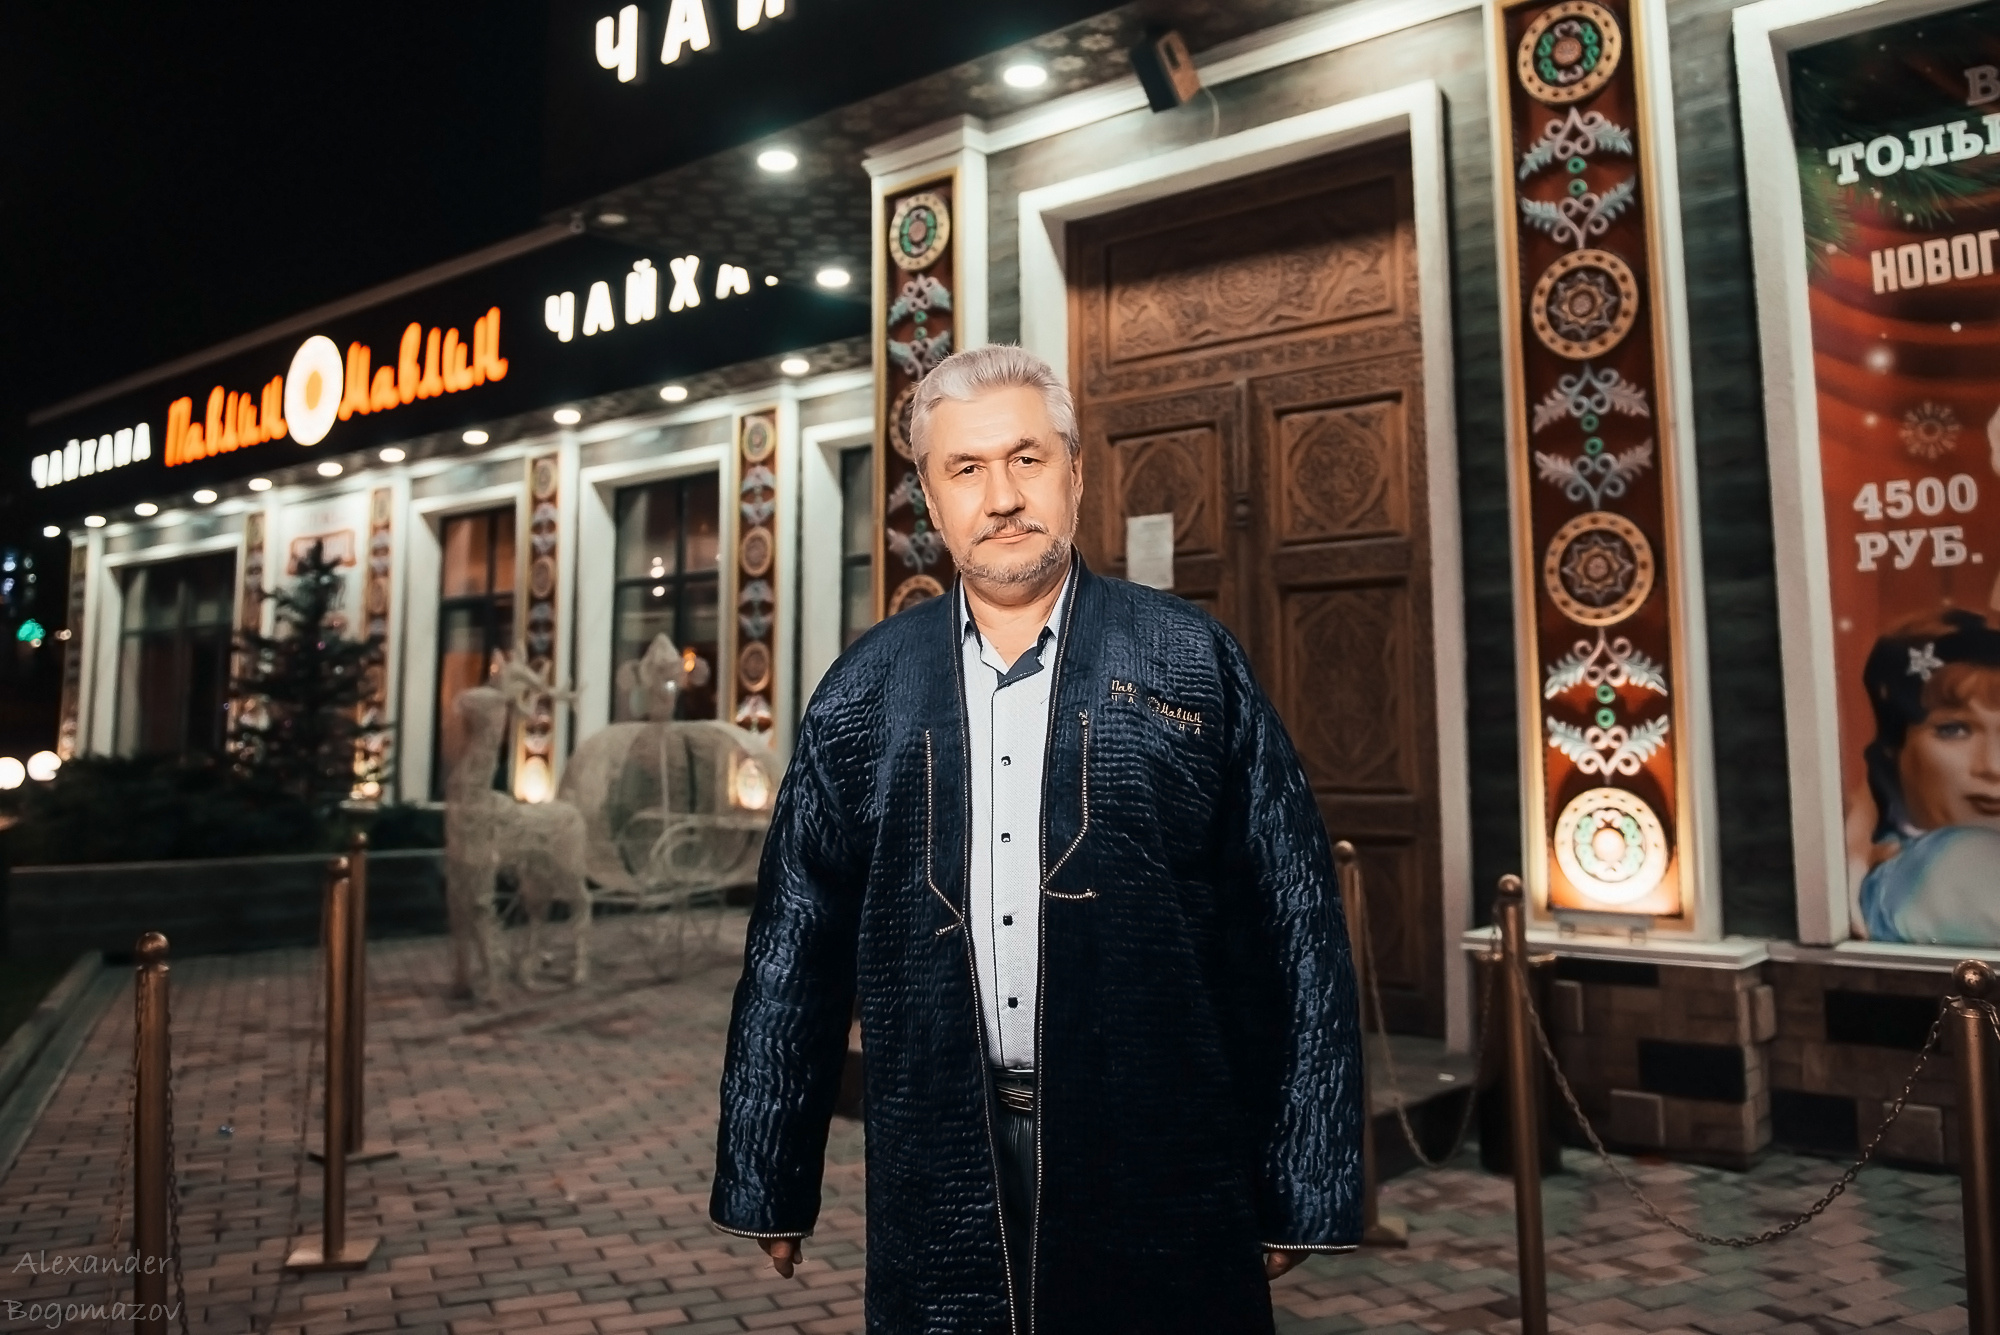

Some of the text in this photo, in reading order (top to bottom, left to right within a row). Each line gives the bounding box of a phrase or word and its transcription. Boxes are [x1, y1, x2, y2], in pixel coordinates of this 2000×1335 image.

[1871, 228, 2000, 295] НОВОГ
[1853, 473, 1978, 520] 4500
[1855, 525, 1983, 572] РУБ.
